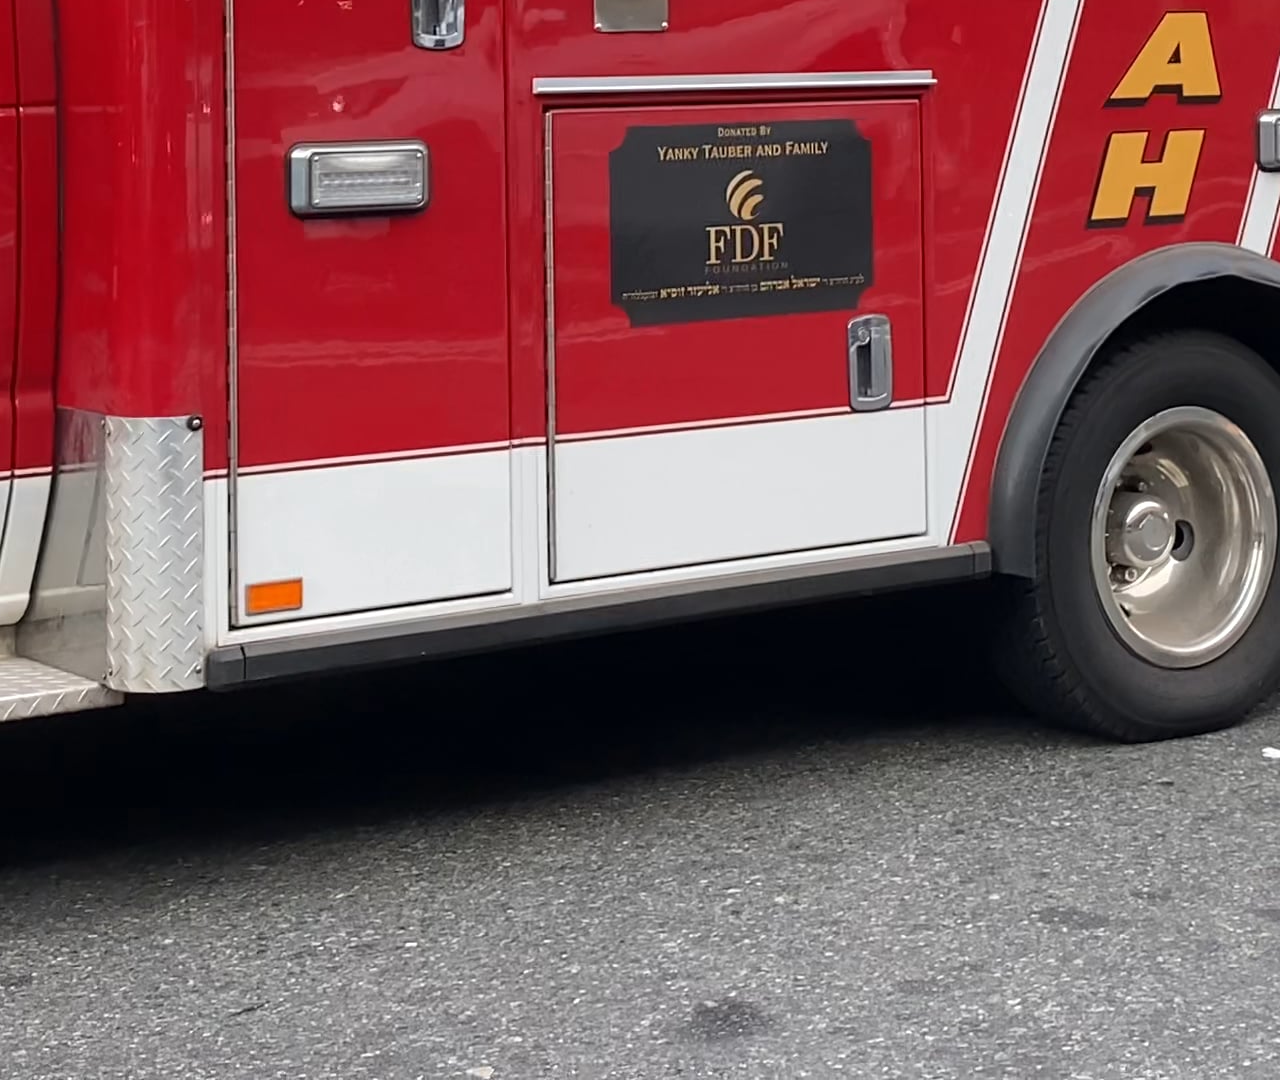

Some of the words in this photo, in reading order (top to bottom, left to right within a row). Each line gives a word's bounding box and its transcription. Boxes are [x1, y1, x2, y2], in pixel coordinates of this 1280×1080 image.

[657, 144, 700, 162] YANKY
[702, 143, 753, 159] TAUBER
[756, 143, 783, 157] AND
[785, 141, 829, 156] FAMILY
[705, 222, 784, 266] FDF
[703, 261, 790, 276] FOUNDATION
